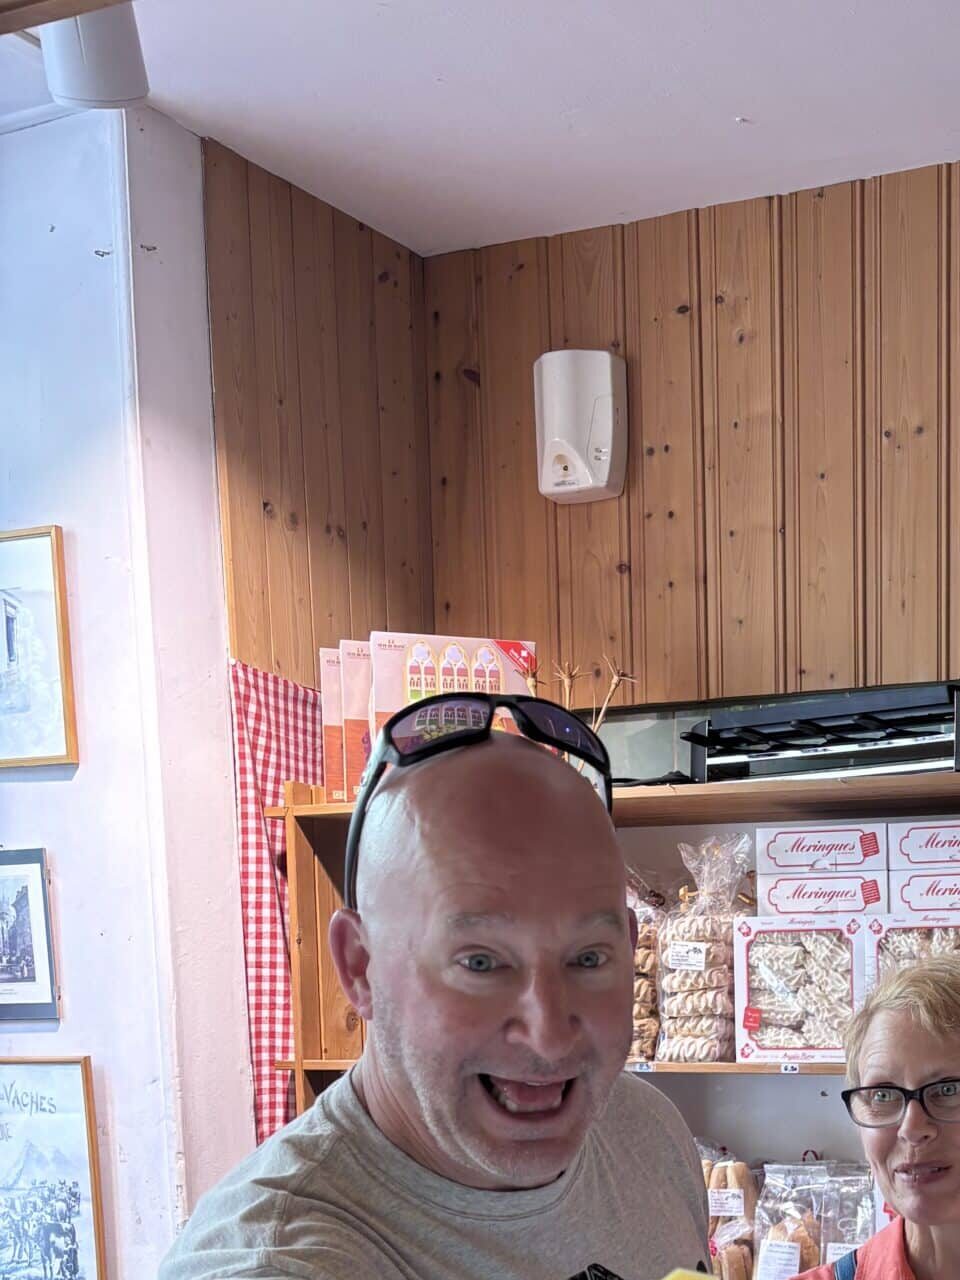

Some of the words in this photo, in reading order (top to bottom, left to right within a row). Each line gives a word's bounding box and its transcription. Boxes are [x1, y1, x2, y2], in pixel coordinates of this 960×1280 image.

[784, 837, 856, 857] Meringues
[786, 883, 857, 904] Meringues
[2, 1079, 57, 1117] VACHES
